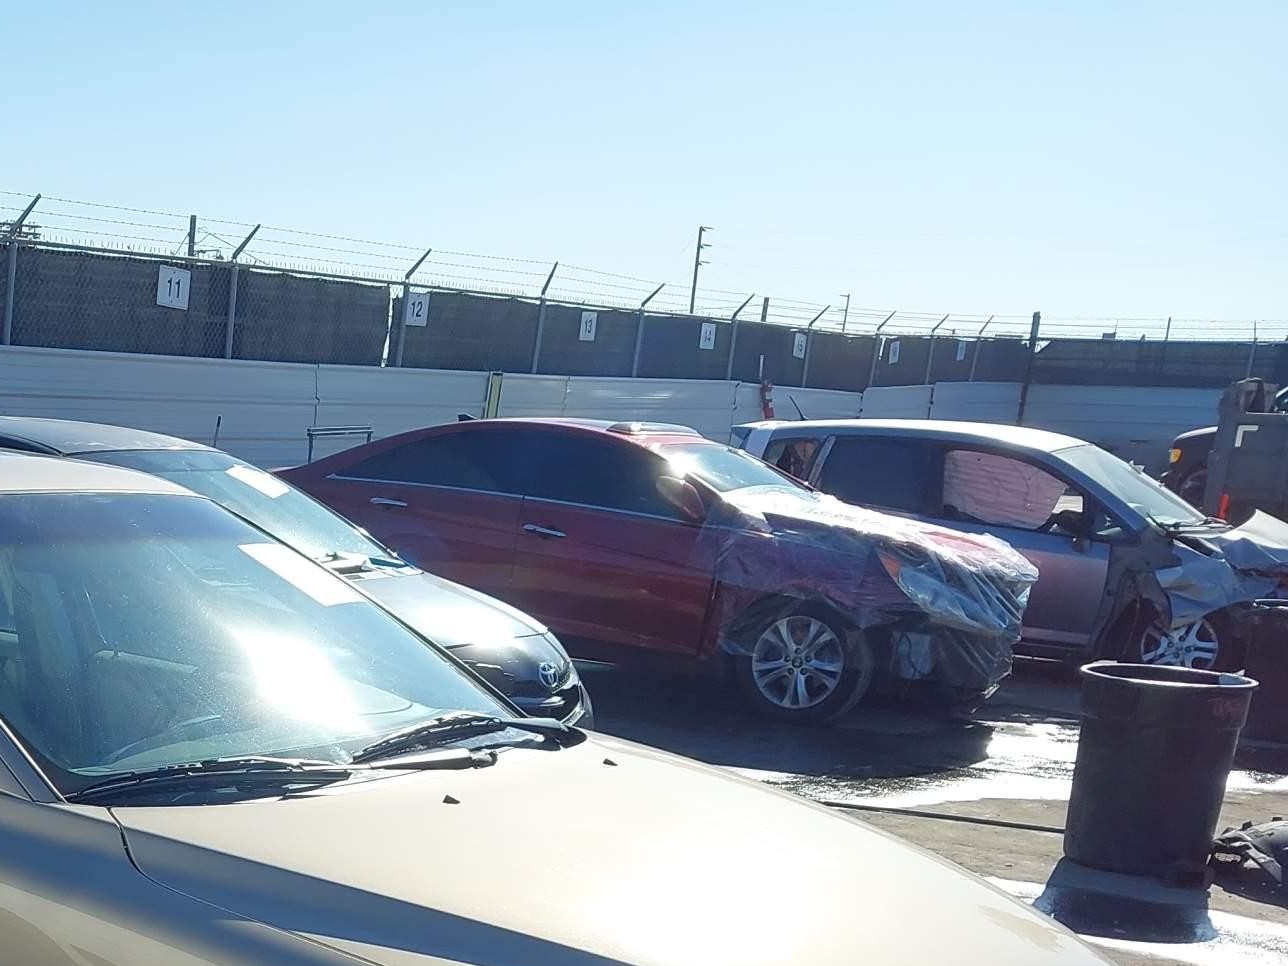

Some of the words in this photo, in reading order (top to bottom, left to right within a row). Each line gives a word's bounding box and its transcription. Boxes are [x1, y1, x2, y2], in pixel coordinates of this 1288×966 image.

[167, 277, 182, 298] 11
[410, 301, 423, 318] 12
[584, 320, 594, 334] 13
